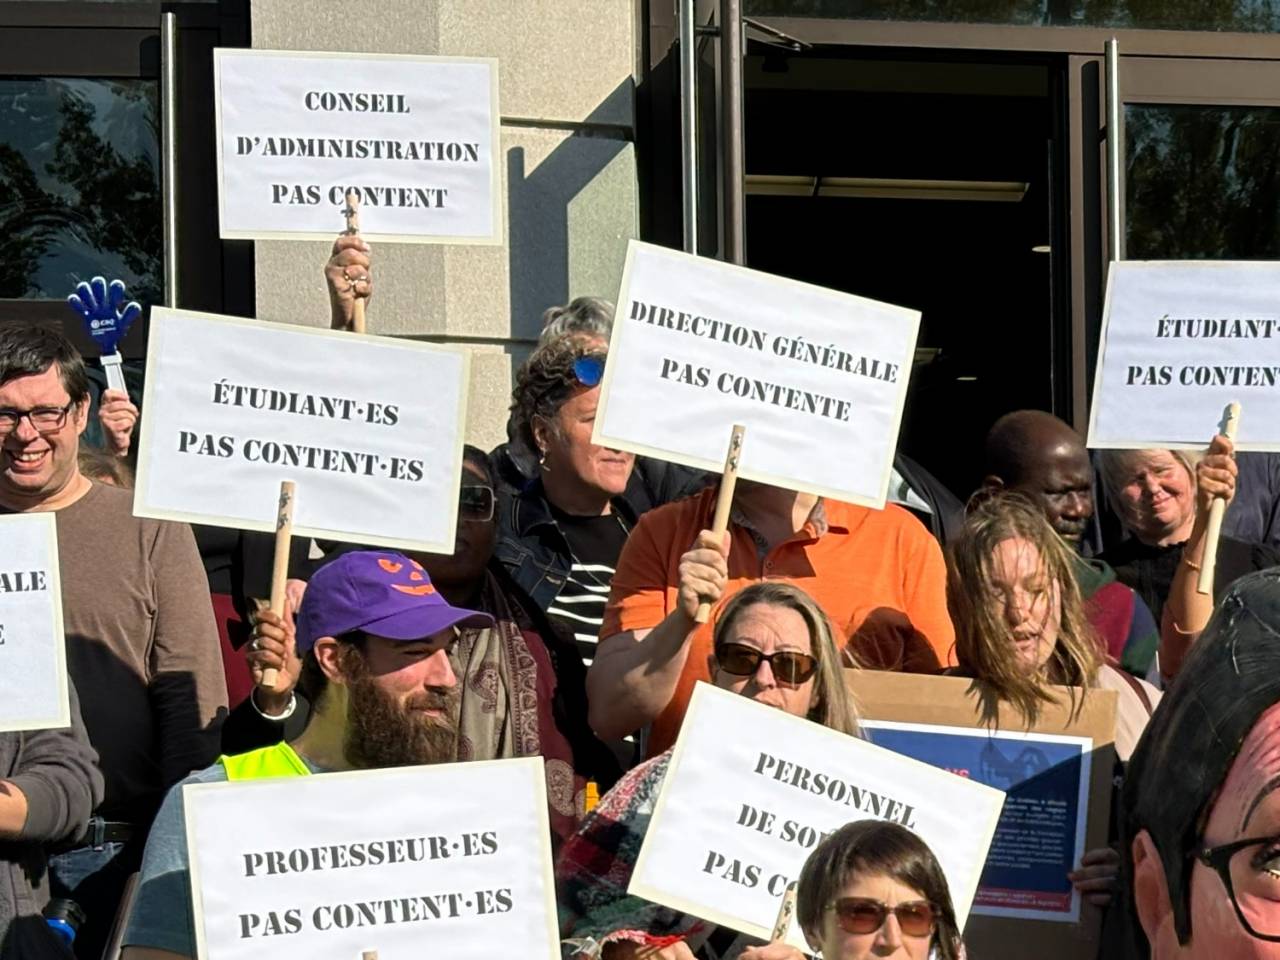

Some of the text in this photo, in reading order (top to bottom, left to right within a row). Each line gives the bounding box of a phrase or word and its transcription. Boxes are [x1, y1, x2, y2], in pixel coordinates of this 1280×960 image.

[306, 92, 409, 113] CONSEIL
[273, 185, 448, 208] PAS CONTENT
[631, 301, 897, 382] DIRECTION GÉNÉRALE
[1127, 366, 1172, 385] PAS
[662, 359, 850, 421] PAS CONTENTE
[179, 432, 234, 457] PAS
[754, 752, 916, 829] PERSONNEL
[738, 805, 775, 834] DE
[704, 852, 761, 887] PAS
[240, 910, 301, 938] PAS
